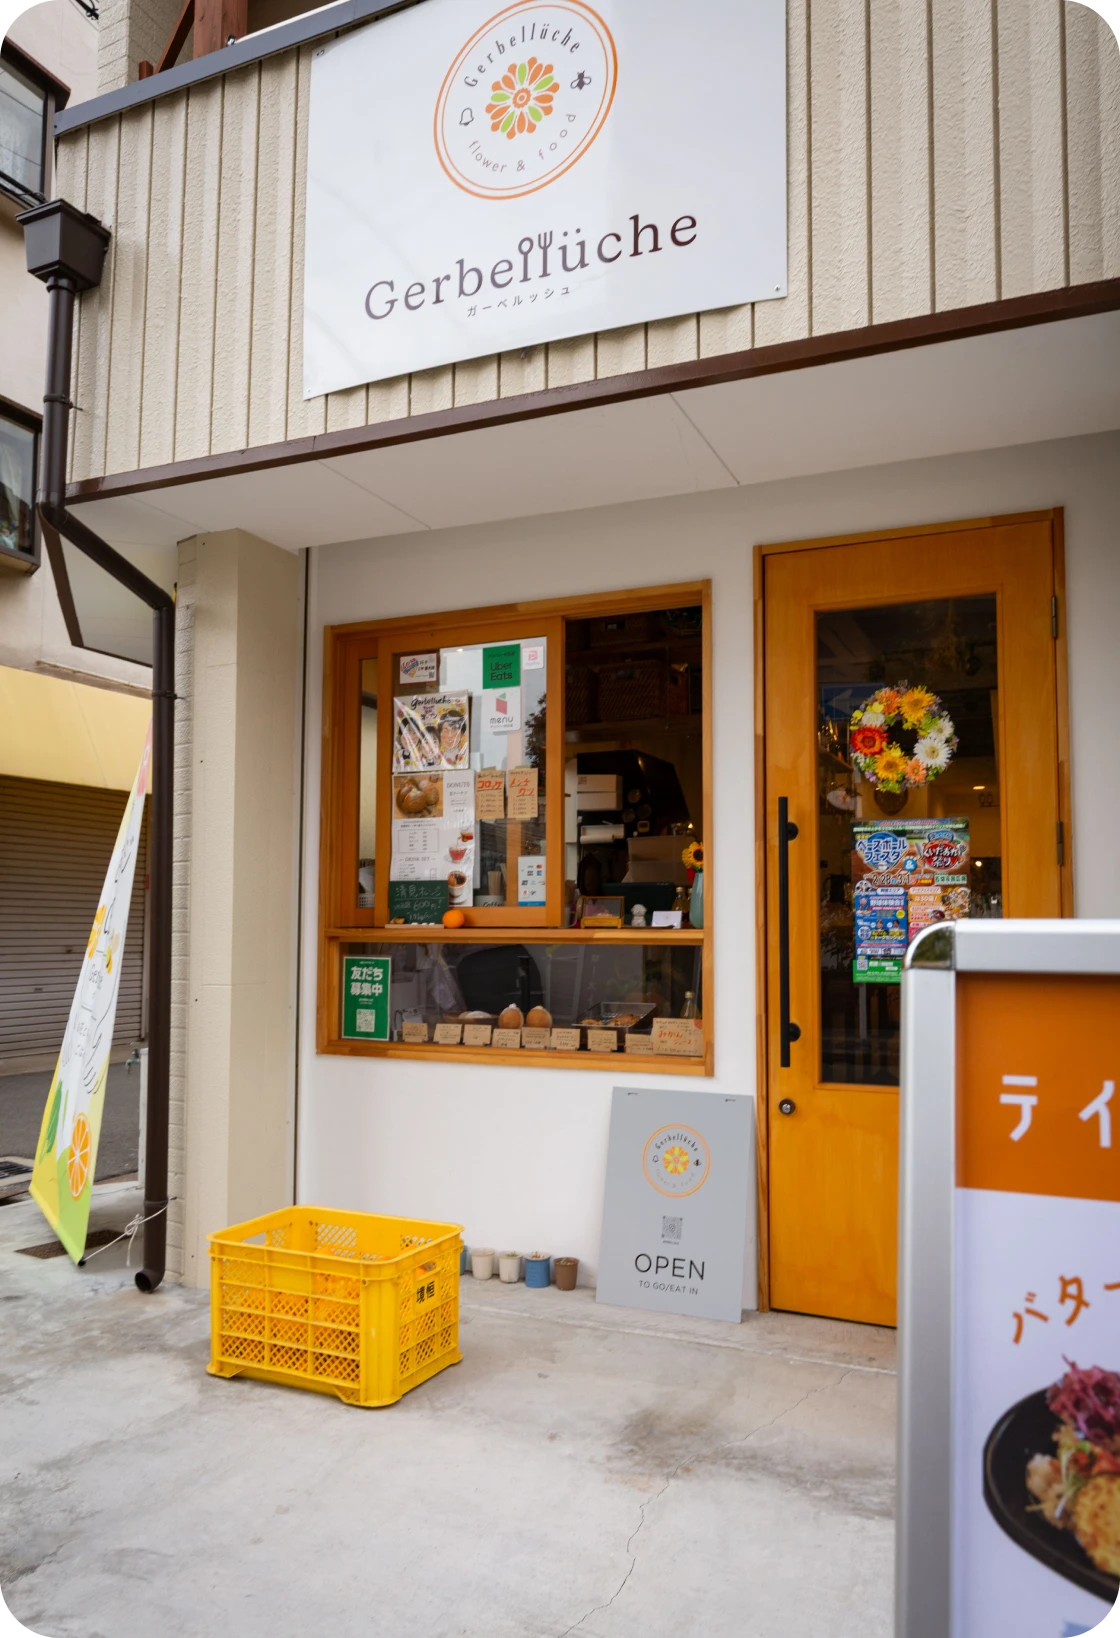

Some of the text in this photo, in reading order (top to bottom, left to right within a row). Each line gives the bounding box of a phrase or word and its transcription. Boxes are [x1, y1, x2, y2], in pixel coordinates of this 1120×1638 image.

[463, 22, 580, 87] Gerbellüche
[468, 113, 576, 173] flower & food
[365, 213, 698, 320] Gerbellüche
[467, 286, 571, 317] ガーベルッシュ
[489, 661, 513, 671] Uber
[489, 671, 513, 681] Eats
[489, 716, 514, 725] menu
[350, 966, 384, 981] 友だち
[350, 982, 383, 996] 募集中
[634, 1253, 706, 1281] OPEN
[638, 1280, 699, 1296] TO GO/EAT IN
